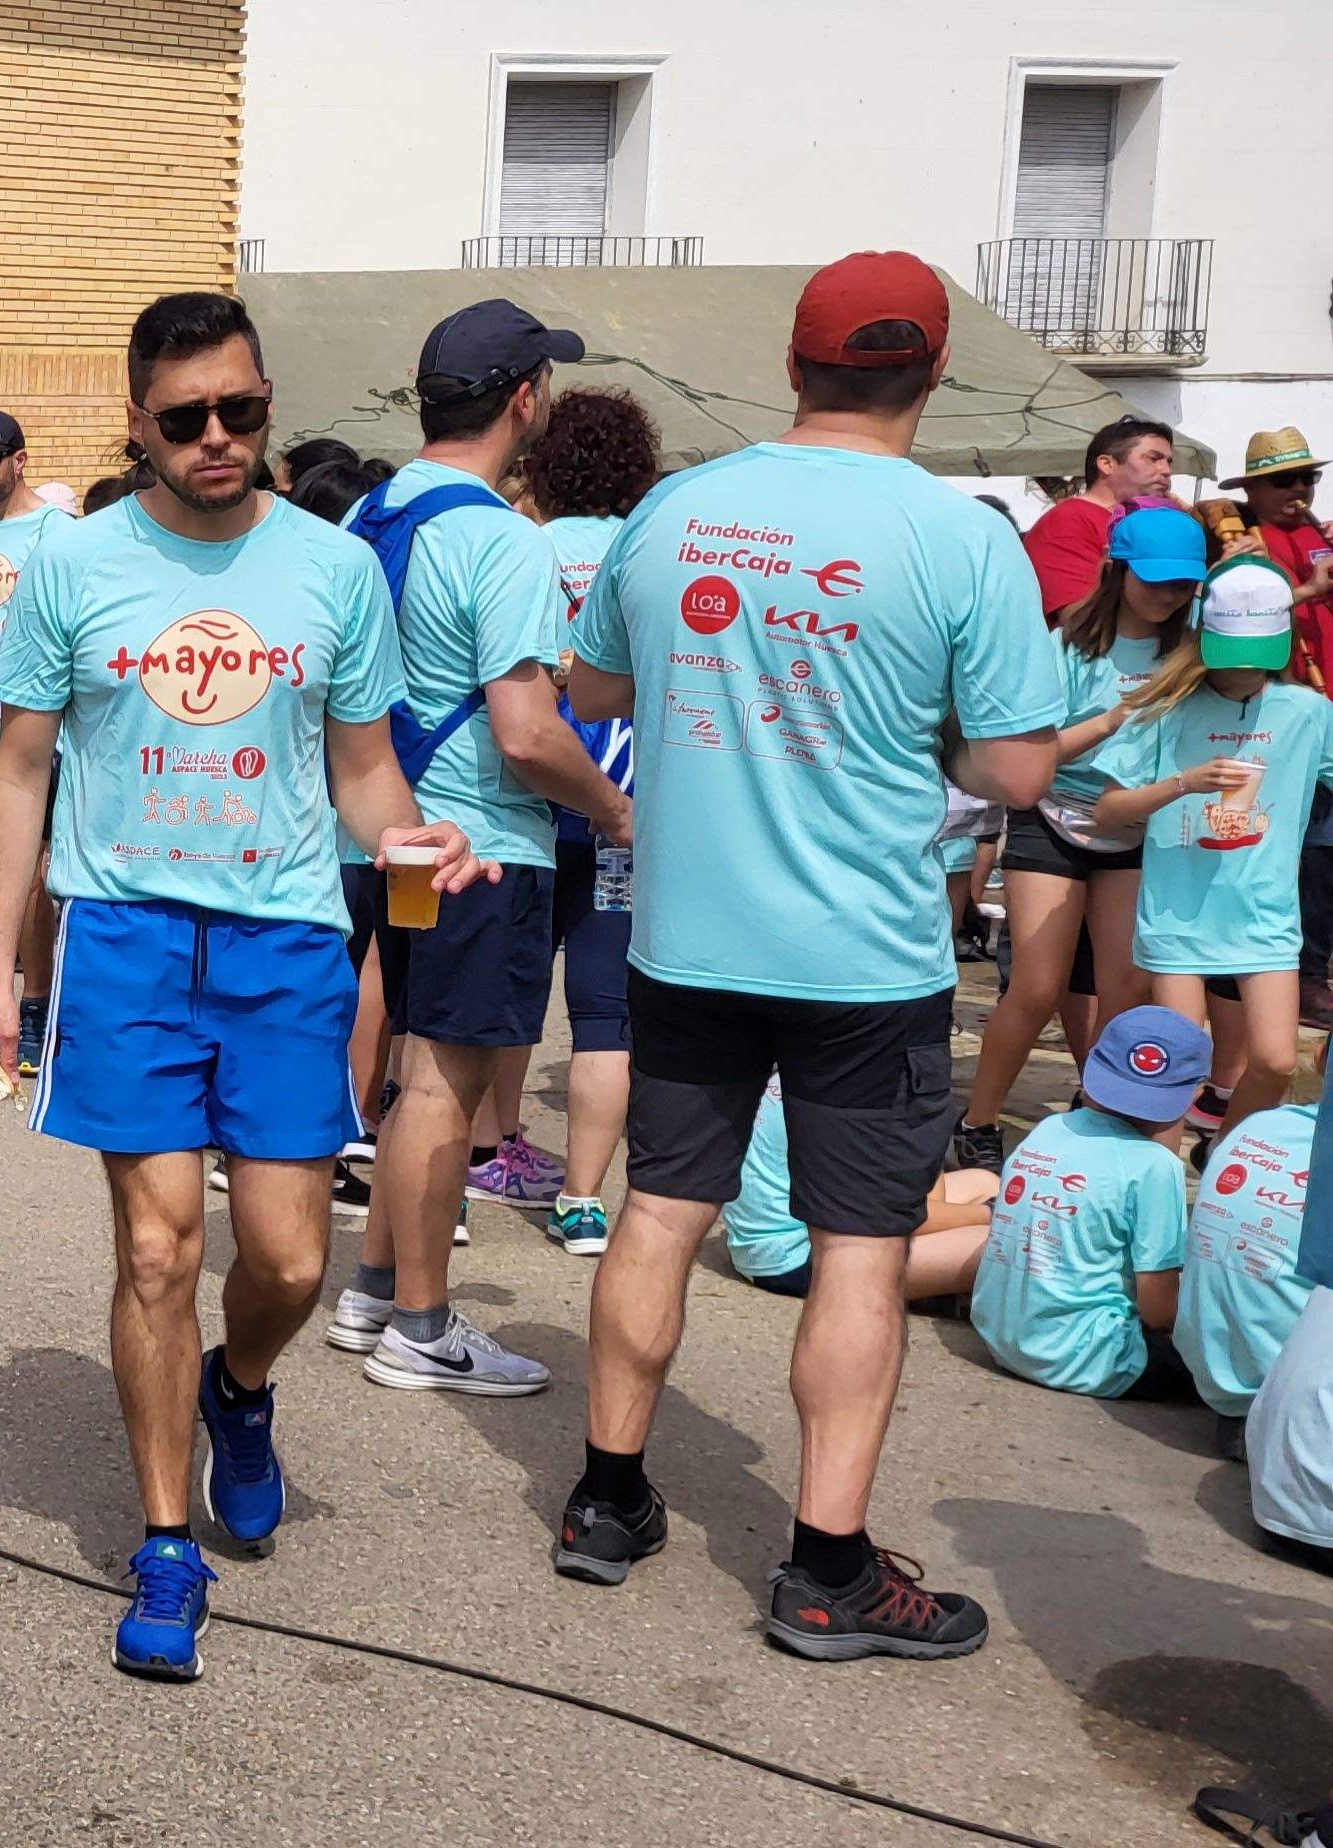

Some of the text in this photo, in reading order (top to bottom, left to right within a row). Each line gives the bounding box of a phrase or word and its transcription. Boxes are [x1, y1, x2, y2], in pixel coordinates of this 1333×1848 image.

[686, 518, 795, 547] Fundación
[677, 542, 793, 578] iberCaja
[106, 642, 306, 697] +mayores
[669, 652, 725, 668] avanza
[758, 672, 841, 704] escanero
